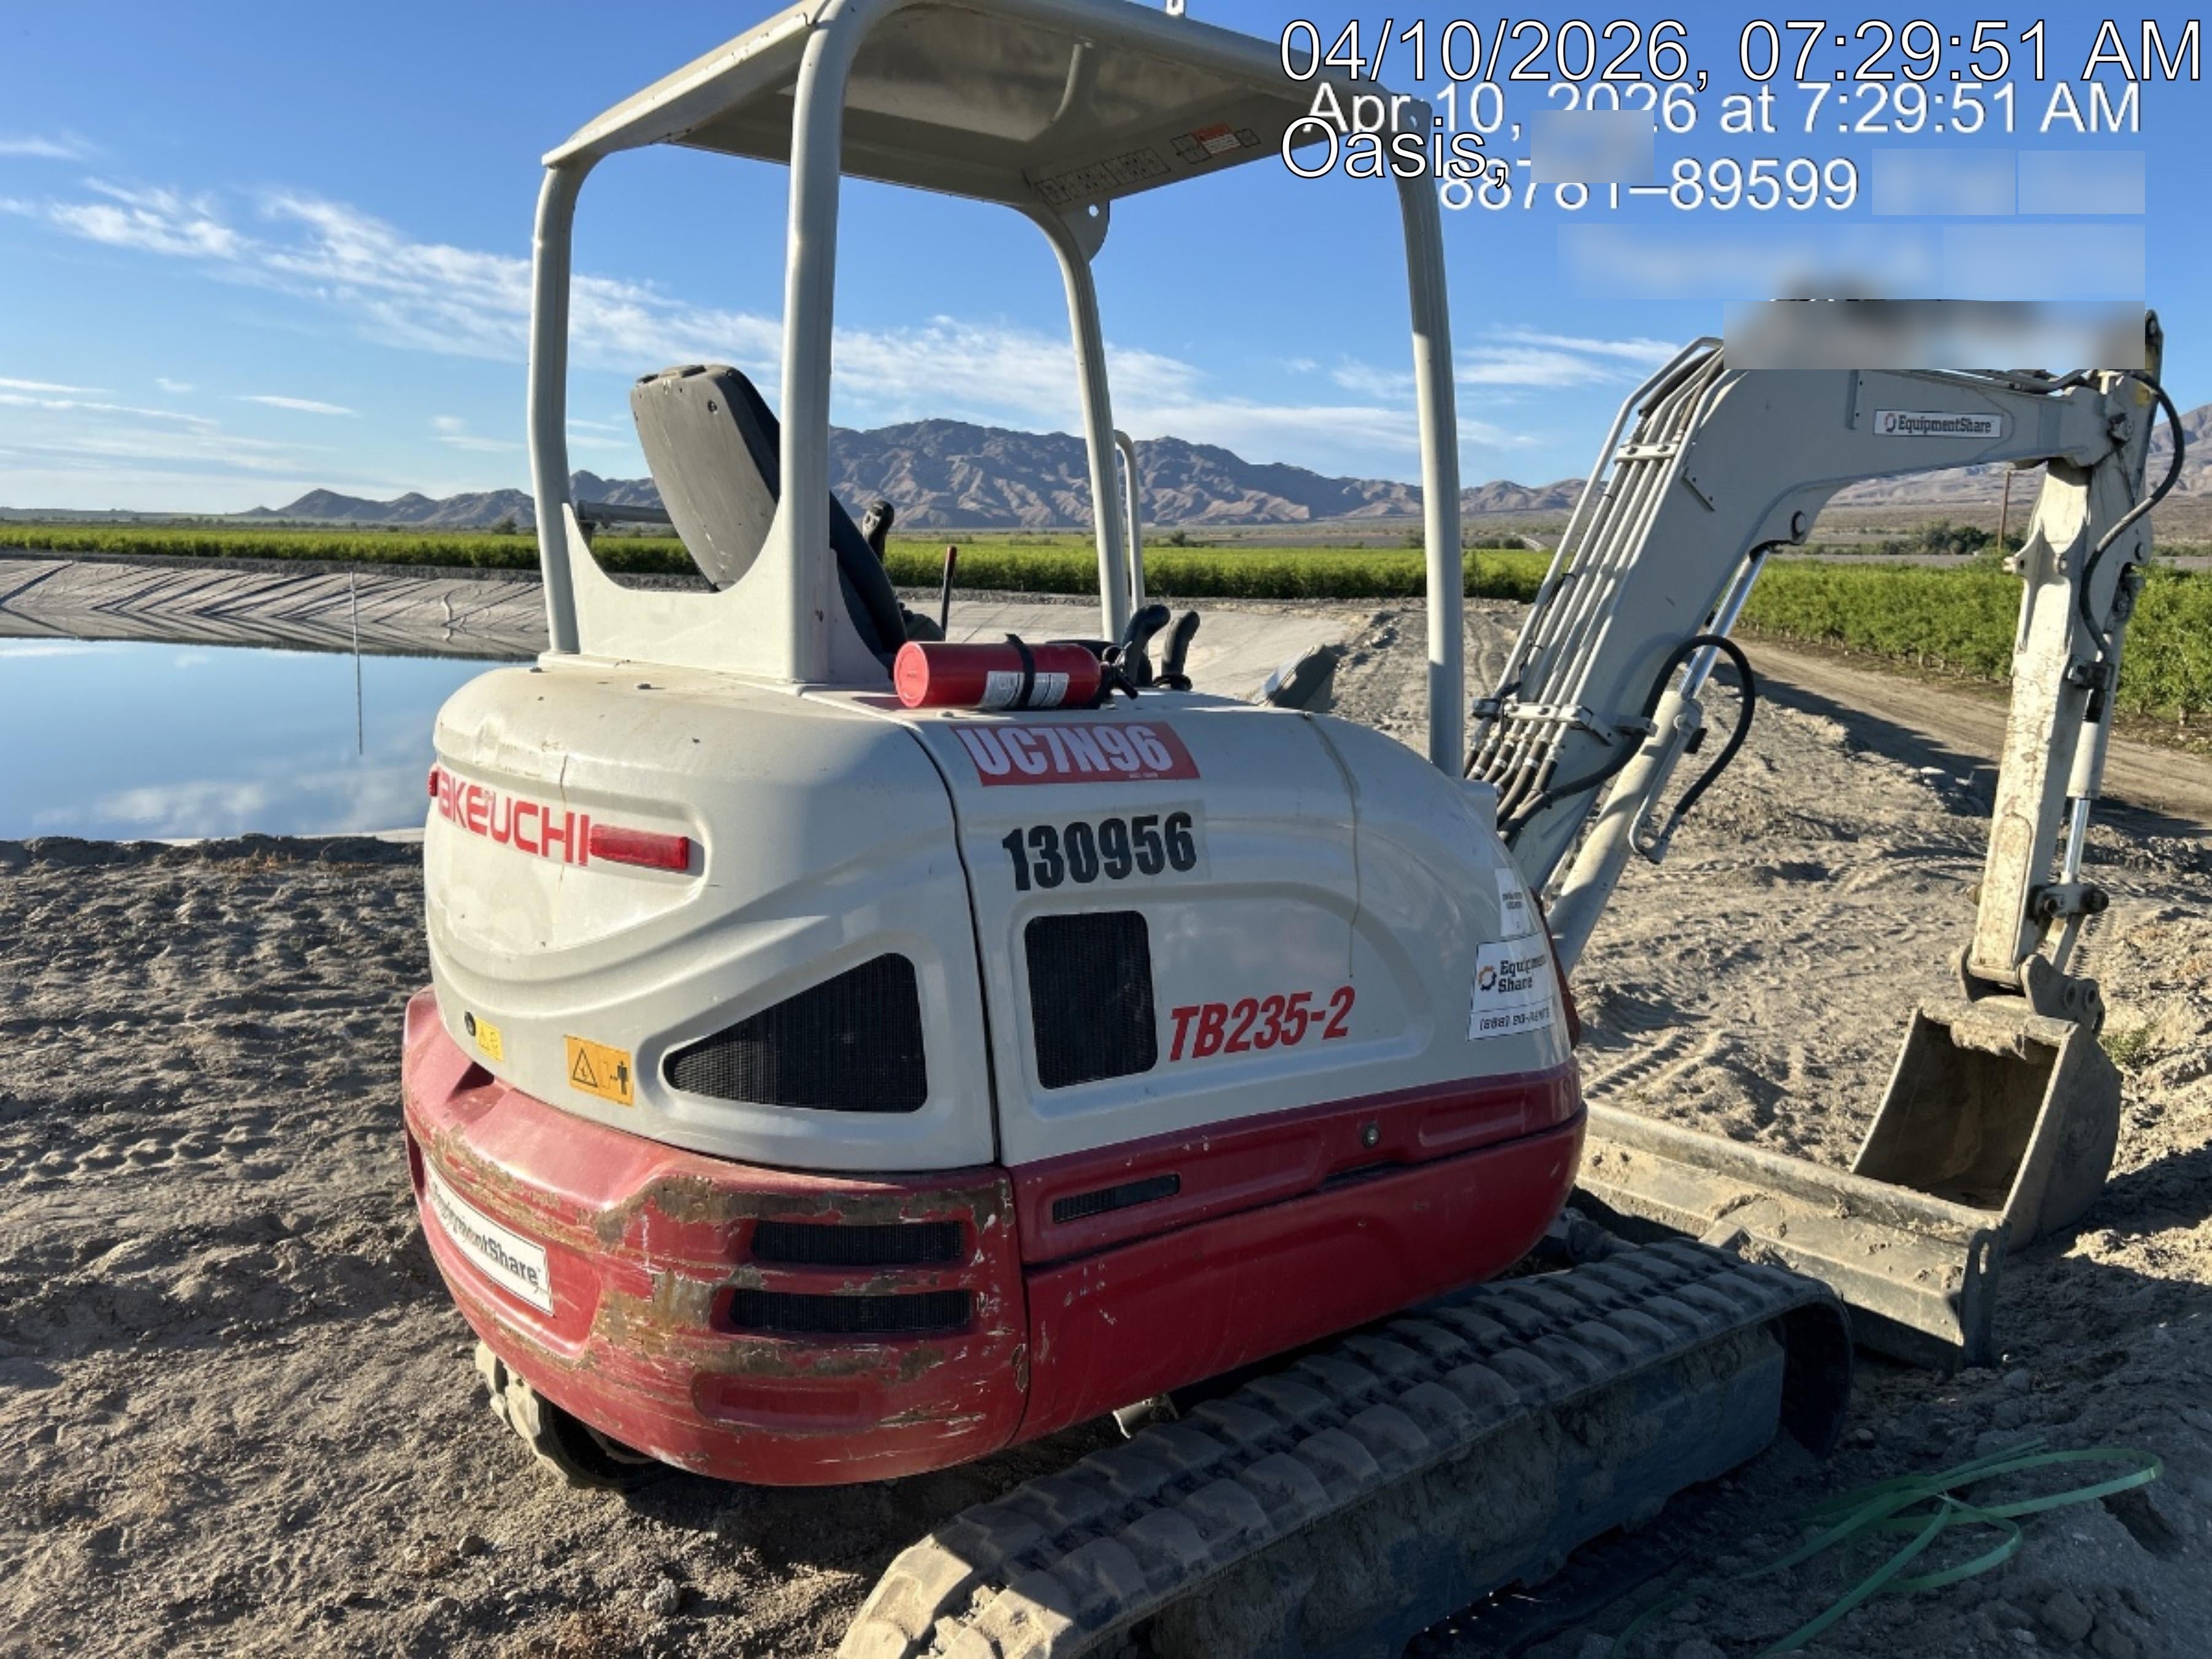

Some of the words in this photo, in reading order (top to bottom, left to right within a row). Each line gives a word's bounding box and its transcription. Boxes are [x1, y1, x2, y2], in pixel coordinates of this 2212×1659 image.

[1898, 414, 1991, 434] EquipmentShare
[955, 725, 1173, 775] UC7N96
[437, 767, 591, 867] AKEUCHI
[1002, 810, 1198, 891] 130956
[1169, 986, 1355, 1062] TB235-2
